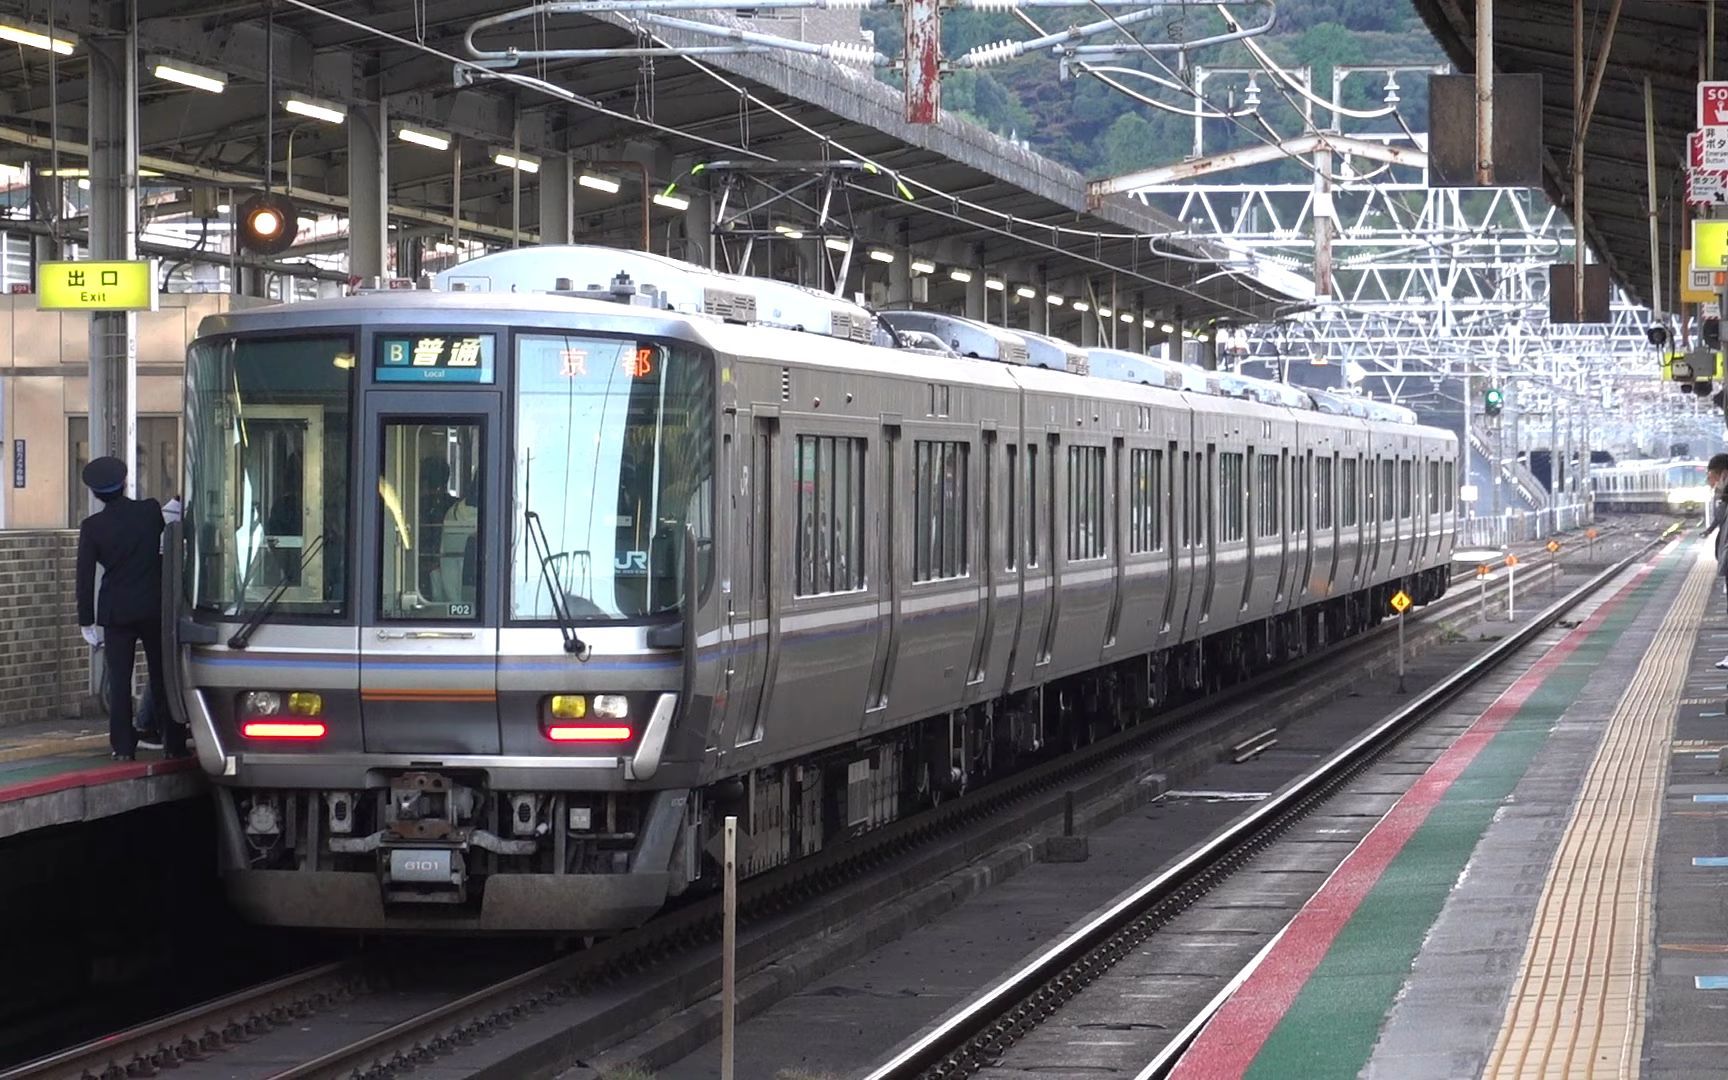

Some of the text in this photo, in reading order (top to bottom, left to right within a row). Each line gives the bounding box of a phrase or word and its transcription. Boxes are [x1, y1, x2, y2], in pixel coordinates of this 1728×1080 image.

[68, 270, 118, 286] 出口
[81, 292, 106, 301] Exit
[391, 338, 480, 366] B 普通
[560, 347, 651, 376] 京都
[424, 370, 445, 378] Local
[615, 551, 647, 569] JR
[451, 604, 470, 615] P02
[405, 861, 438, 870] 6101
